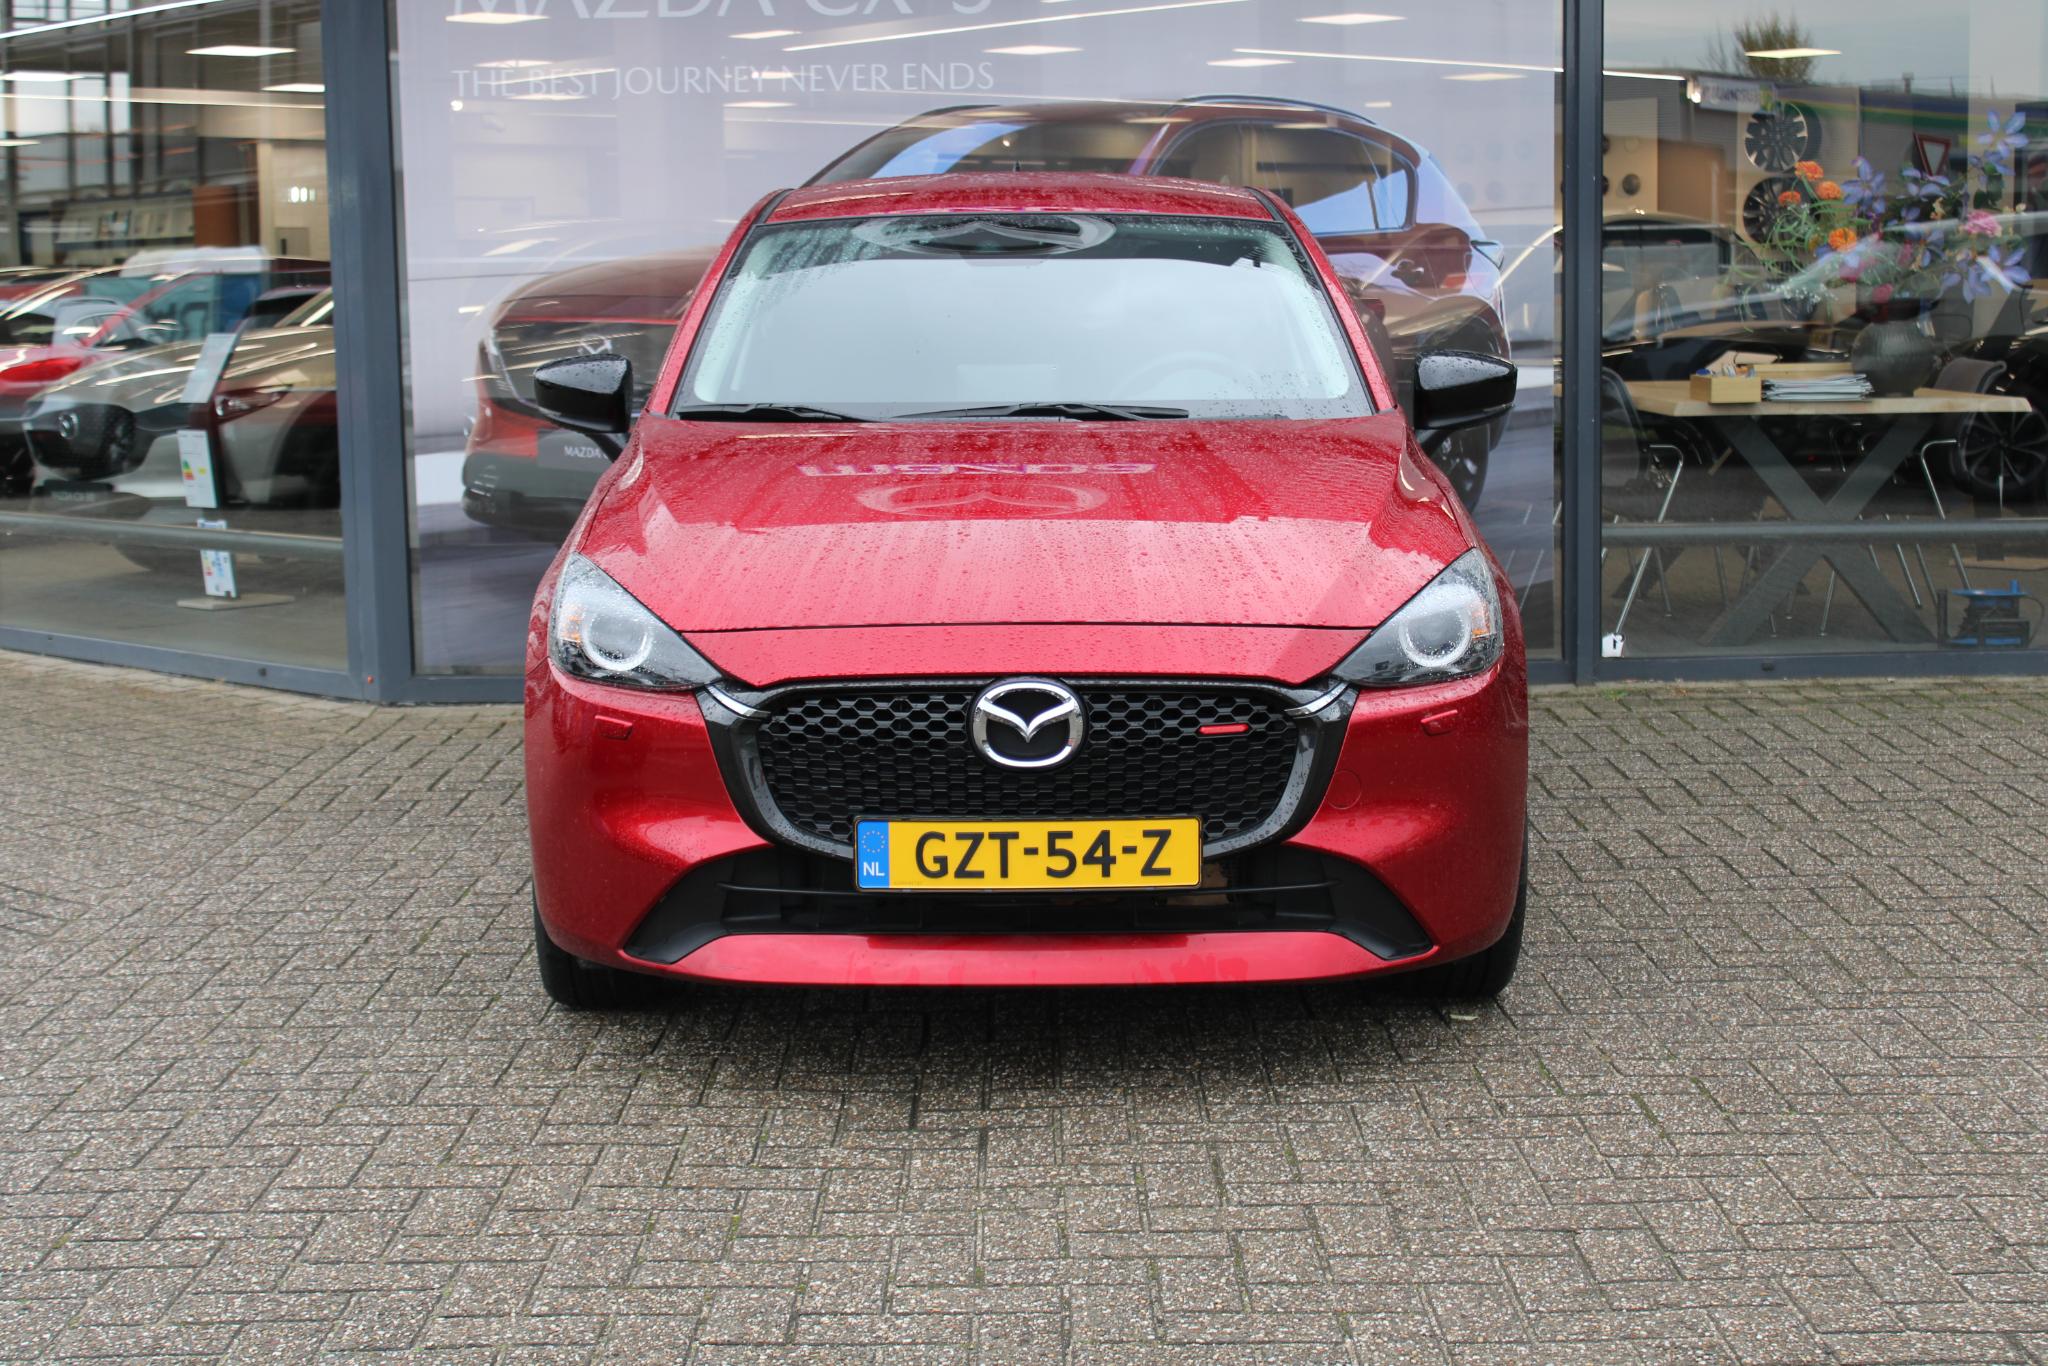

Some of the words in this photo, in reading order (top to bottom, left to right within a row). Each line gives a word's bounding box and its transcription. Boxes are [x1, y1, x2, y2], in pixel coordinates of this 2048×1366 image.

[452, 70, 514, 97] THE
[529, 68, 600, 96] BEST
[612, 66, 765, 99] JOURNEY
[780, 63, 892, 92] NEVER
[902, 62, 994, 90] ENDS
[564, 446, 602, 459] MAZDA
[915, 829, 1172, 879] GZT-54-Z
[863, 862, 885, 876] NL
